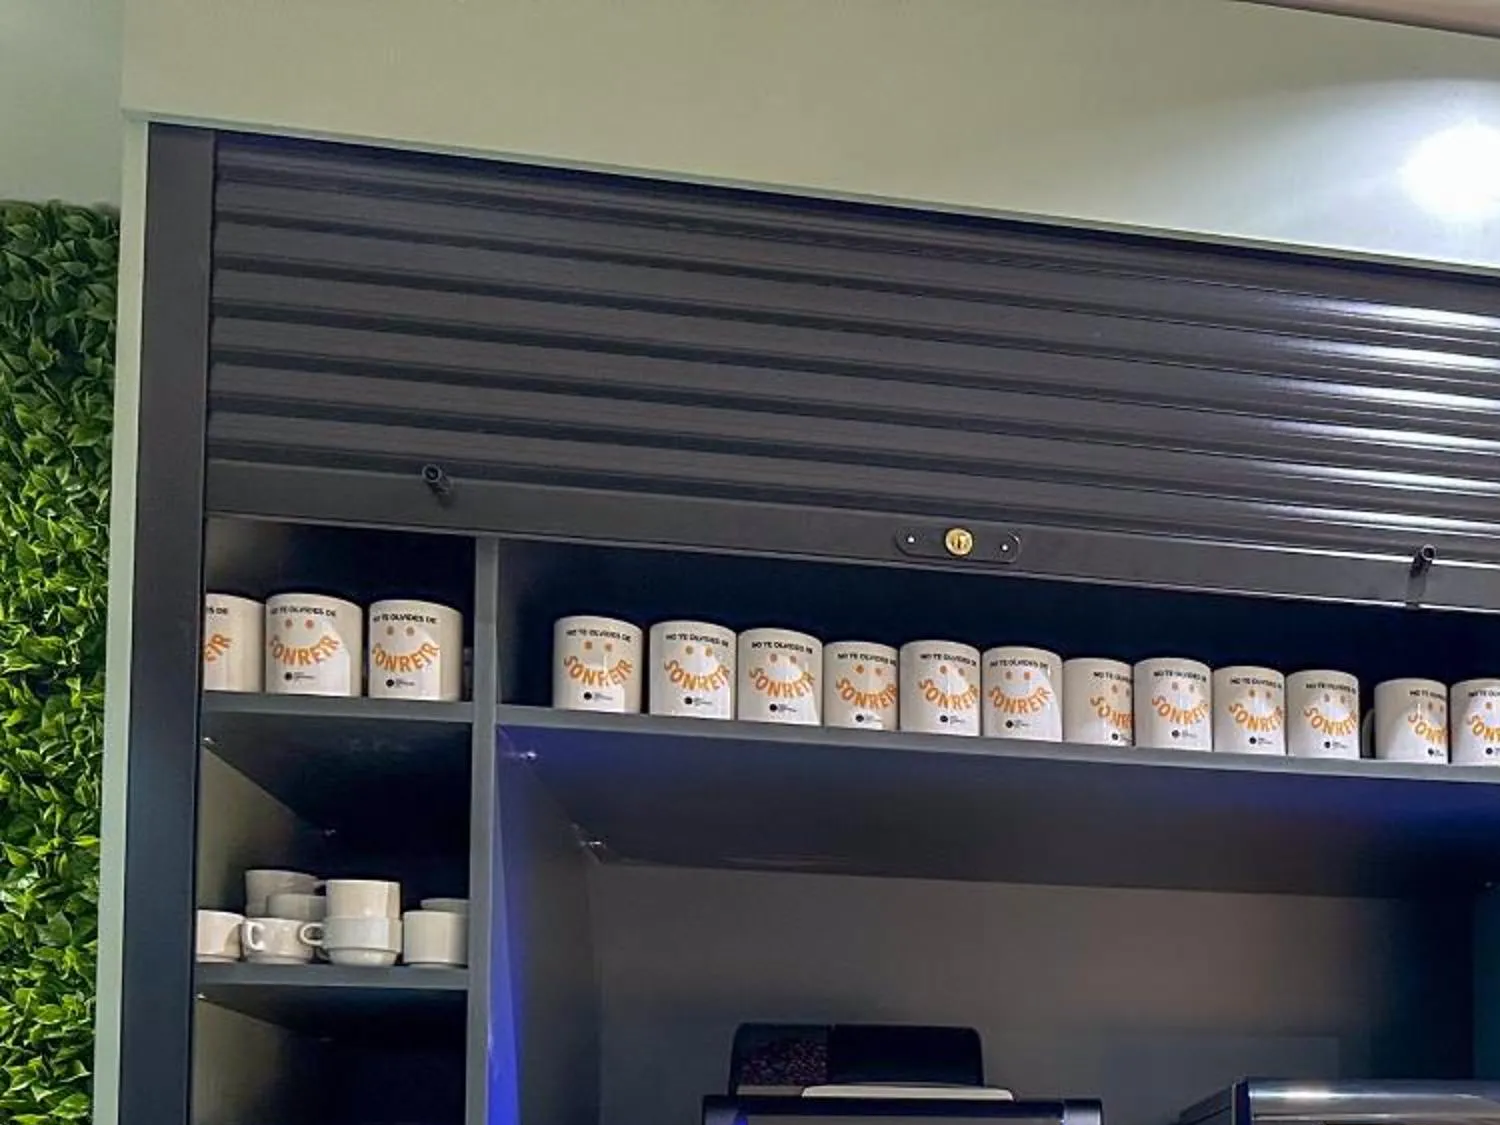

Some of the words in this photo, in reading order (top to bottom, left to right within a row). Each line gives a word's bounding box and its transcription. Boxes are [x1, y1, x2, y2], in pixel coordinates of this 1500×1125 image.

[372, 643, 440, 673] SONREIR
[564, 656, 632, 687] SONREIR
[664, 659, 730, 691] SONREIR
